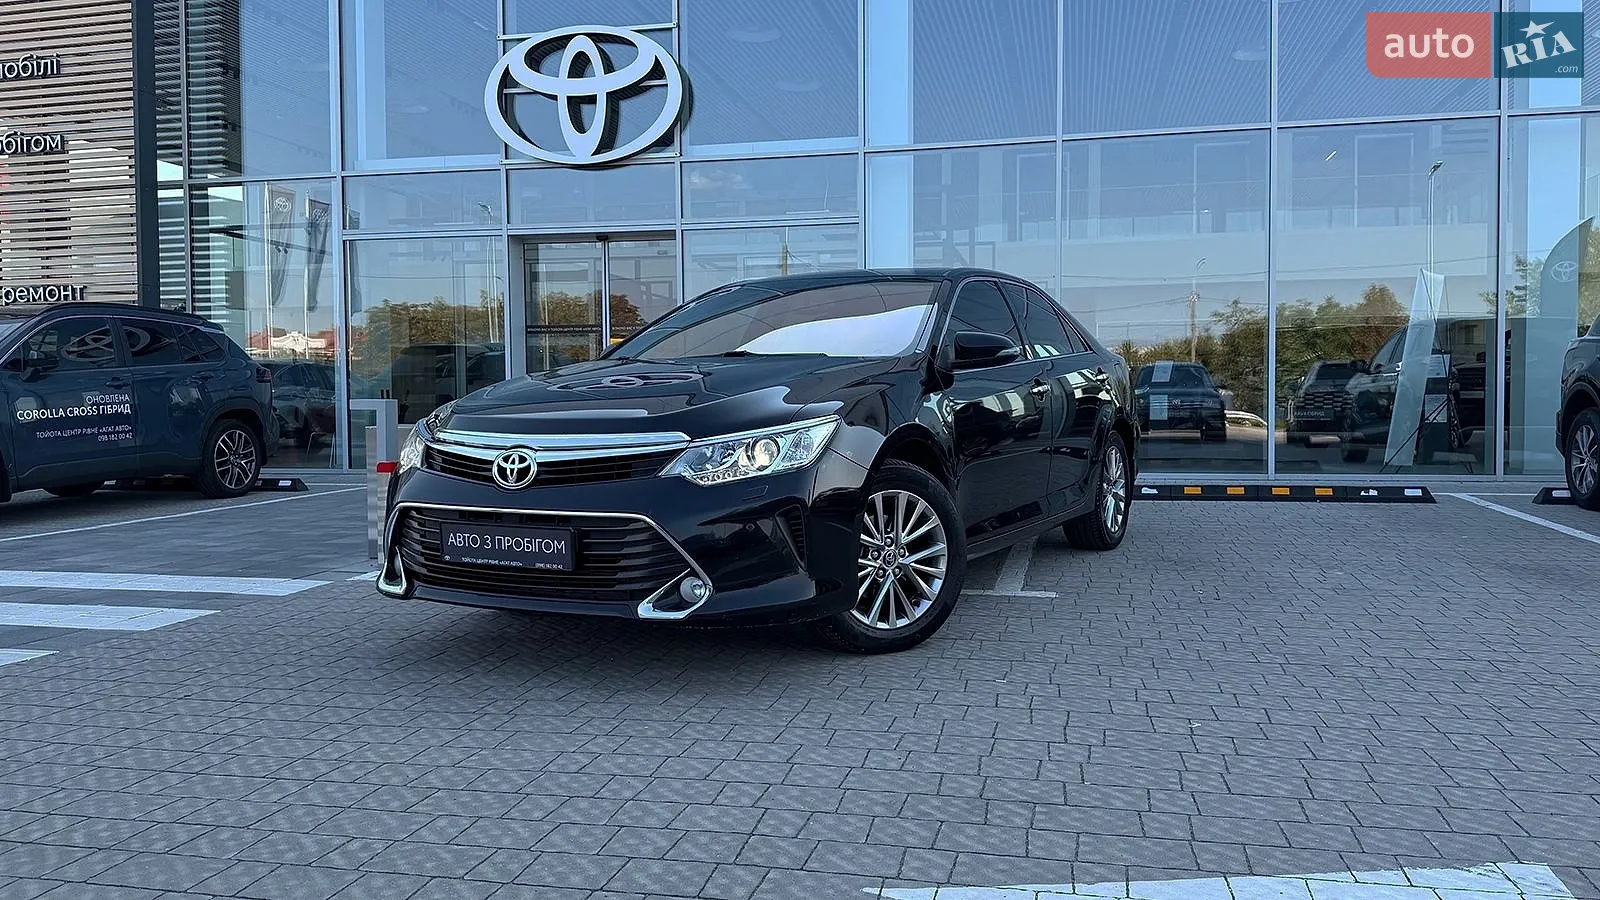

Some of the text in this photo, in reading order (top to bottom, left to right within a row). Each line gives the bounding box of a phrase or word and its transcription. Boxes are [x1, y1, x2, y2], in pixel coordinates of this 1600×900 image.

[0, 53, 57, 79] обілі
[0, 131, 61, 154] бігом
[2, 285, 84, 306] ремонт
[86, 393, 130, 405] ОНОВЛЕНА
[17, 403, 132, 420] COROLLA CROSS ГІБРИД
[62, 428, 82, 437] ЦЕНТР
[447, 532, 481, 548] АВТО
[495, 536, 566, 555] ПРОБІГОМ
